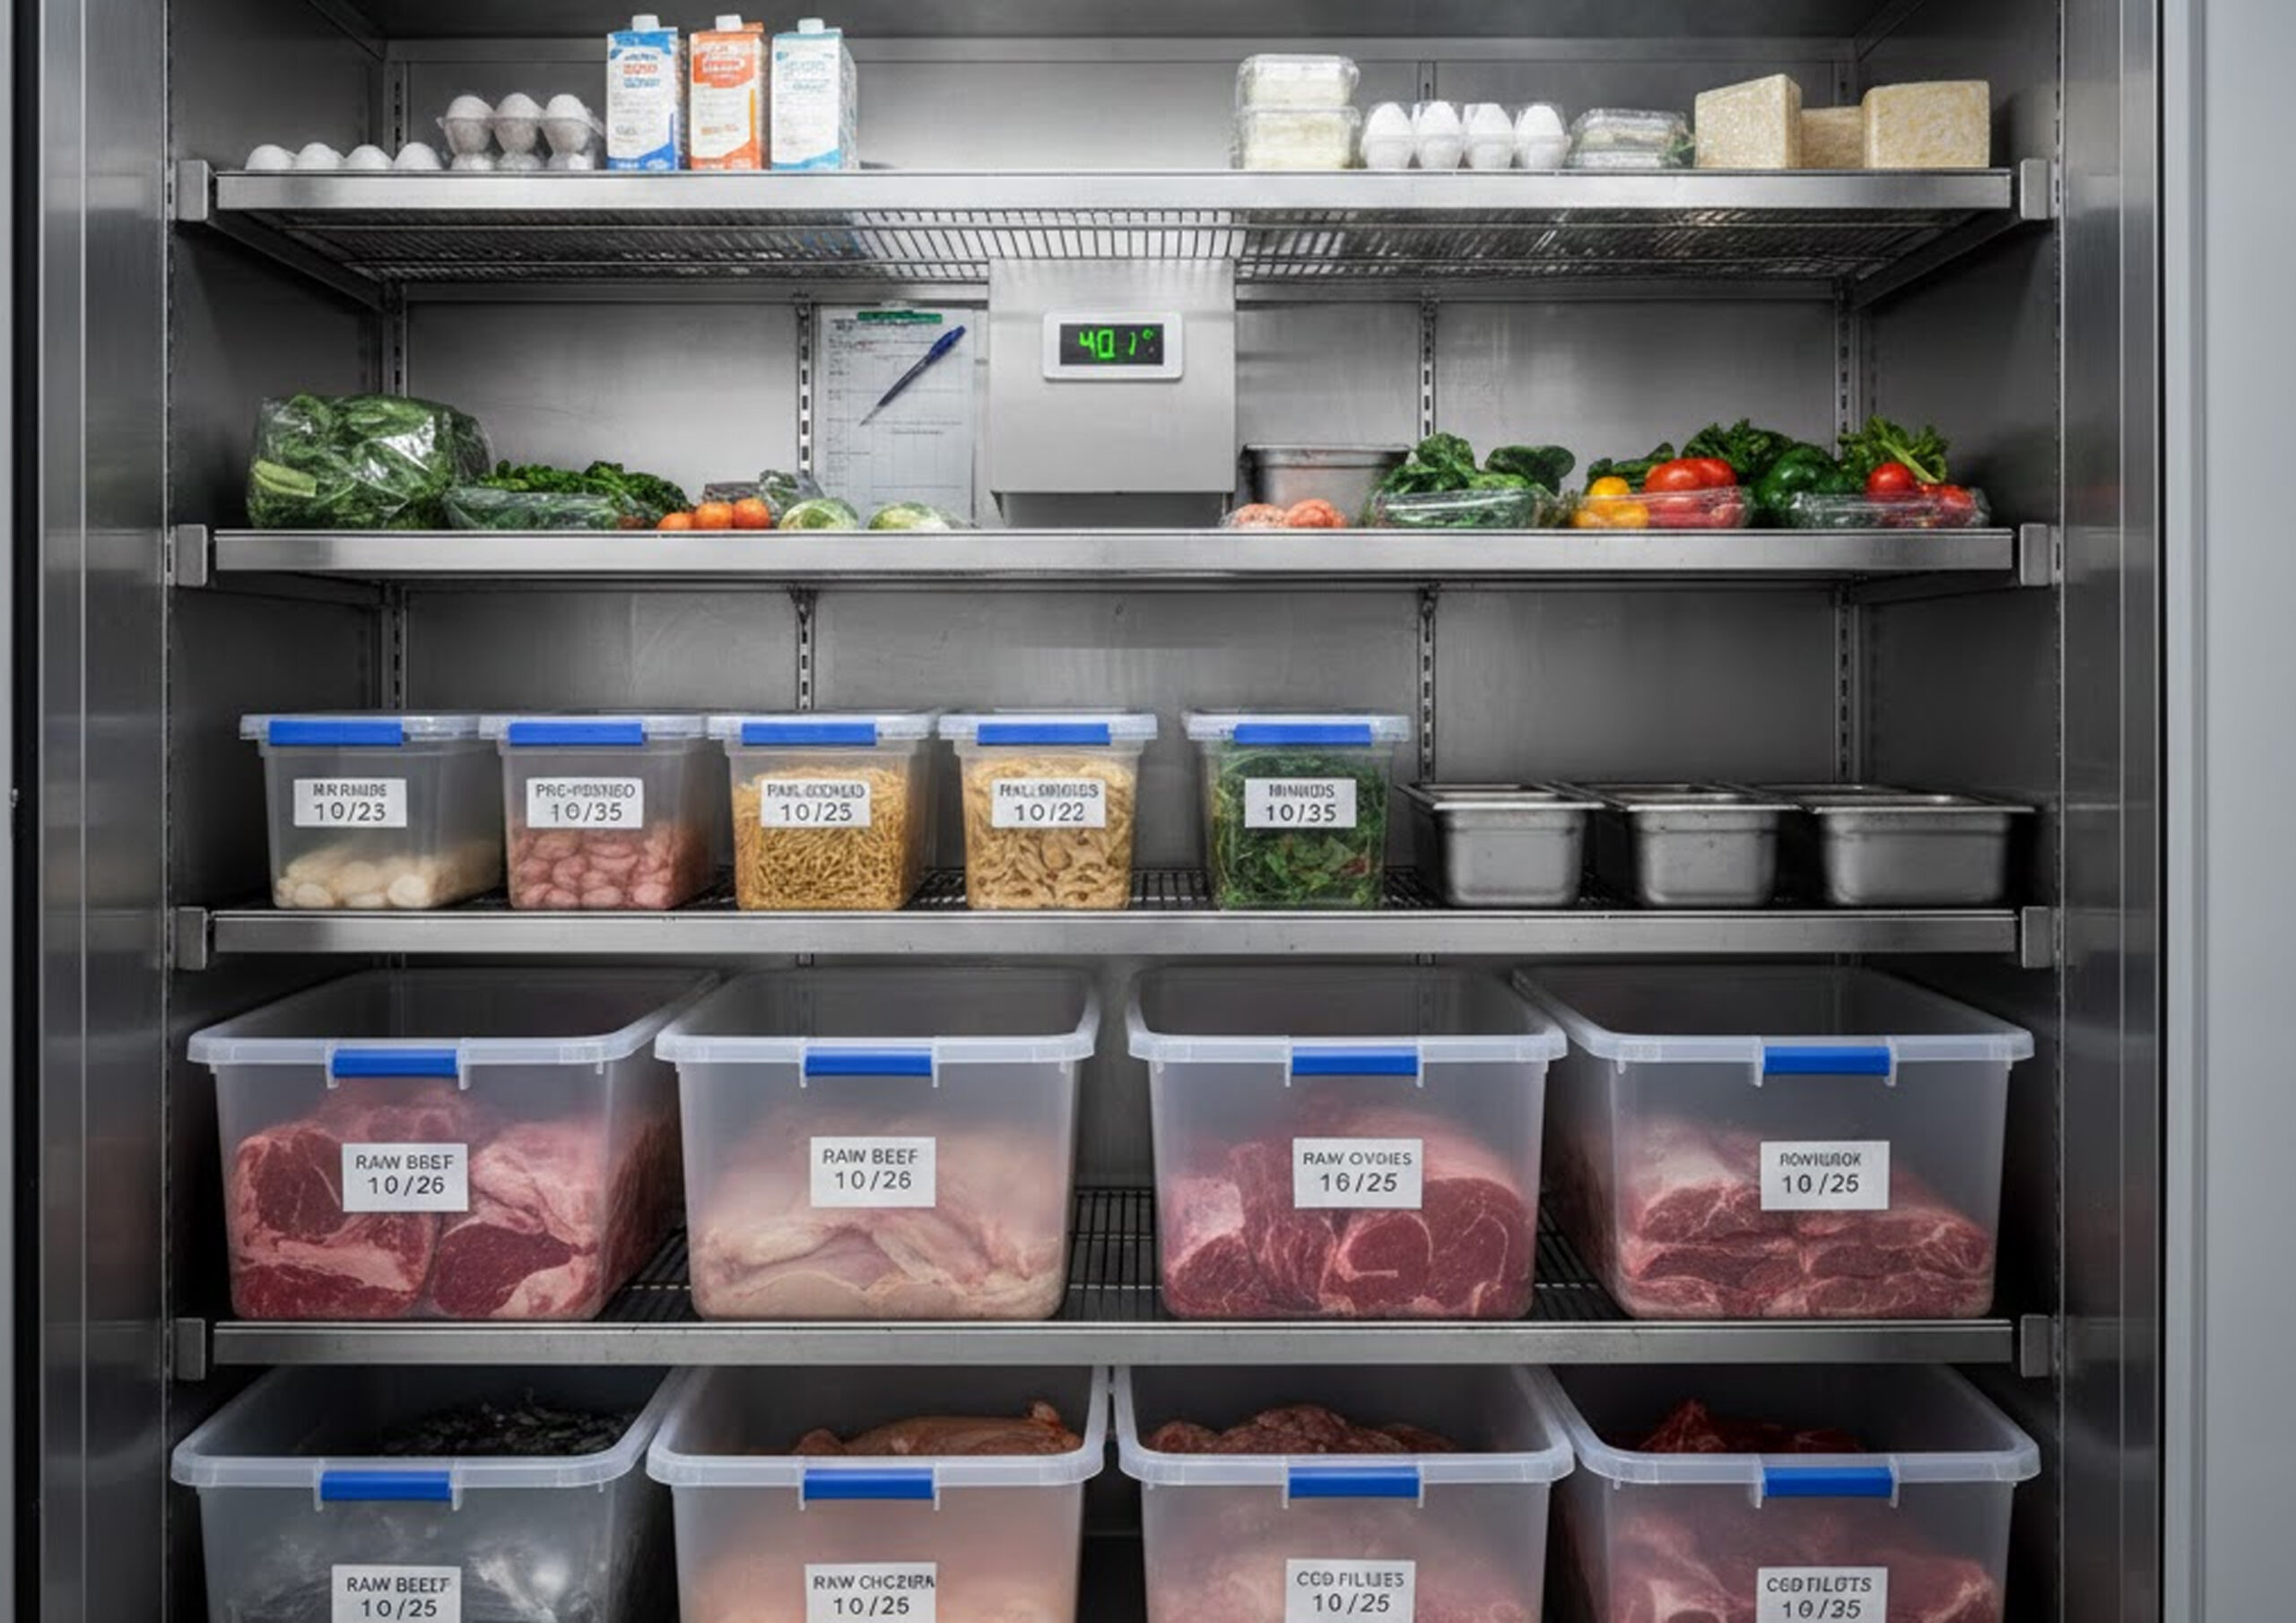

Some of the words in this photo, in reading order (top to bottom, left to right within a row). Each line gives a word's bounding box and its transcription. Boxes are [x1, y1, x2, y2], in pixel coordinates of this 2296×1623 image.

[314, 802, 386, 821] 10/23
[551, 802, 622, 822] 10/35
[1265, 803, 1336, 822] 10/35
[872, 1148, 918, 1165] BEEF
[1303, 1152, 1344, 1165] RAW
[368, 1175, 444, 1196] 10/26
[835, 1170, 911, 1191] 10/26
[1782, 1173, 1859, 1195] 10/25
[347, 1576, 391, 1592] RAW
[813, 1575, 855, 1590] RAW
[361, 1598, 437, 1620] 10/25
[834, 1596, 909, 1617] 10/25
[1313, 1593, 1390, 1614] 10/25
[1783, 1599, 1861, 1619] 10/35
